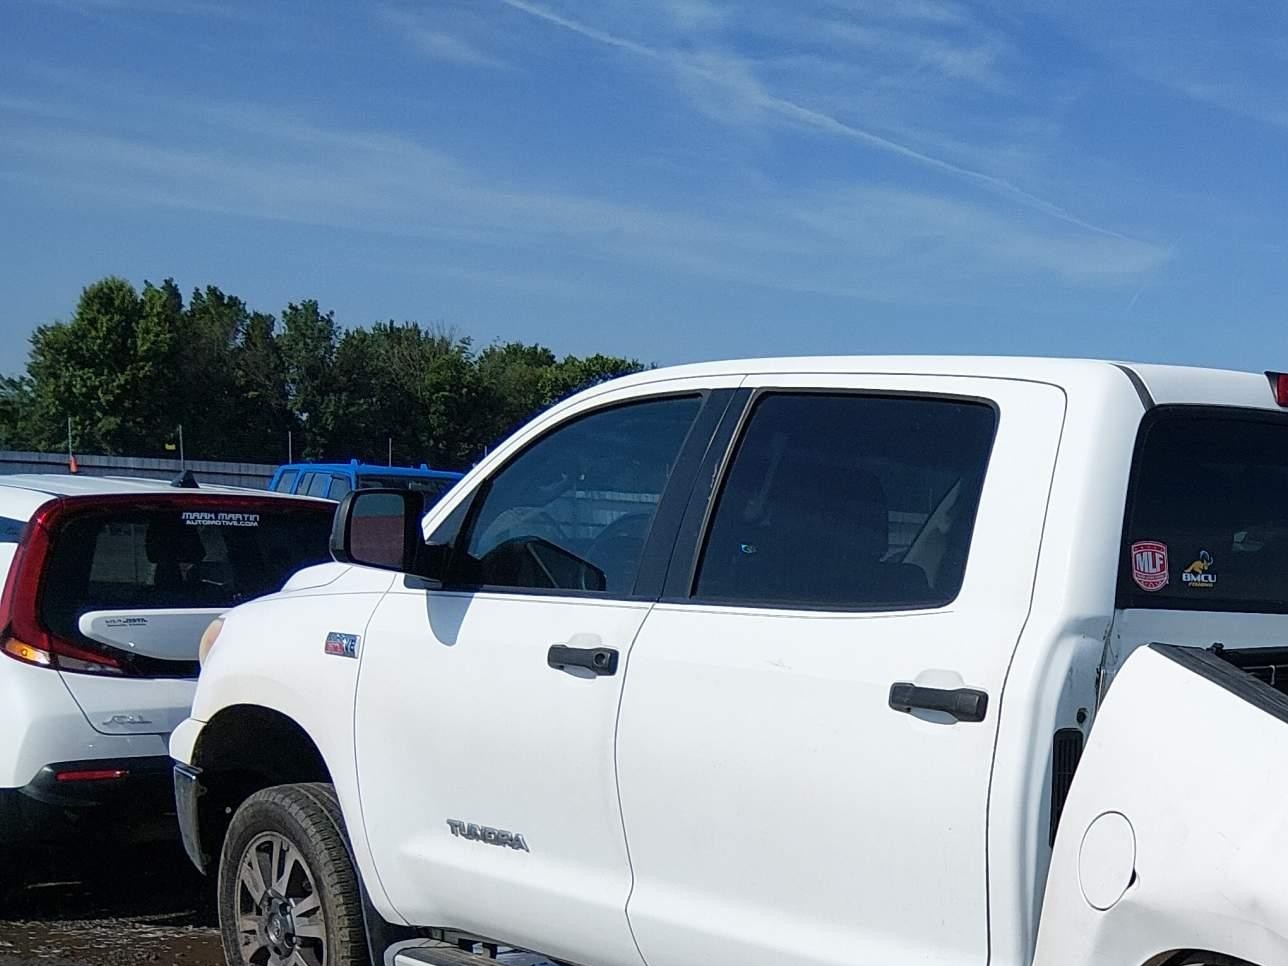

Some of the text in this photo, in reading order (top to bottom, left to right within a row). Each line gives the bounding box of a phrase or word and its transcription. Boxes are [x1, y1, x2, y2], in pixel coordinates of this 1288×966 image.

[182, 512, 260, 521] MARK MARTIN
[1135, 551, 1164, 574] MLF
[446, 818, 530, 853] TUNDRA
